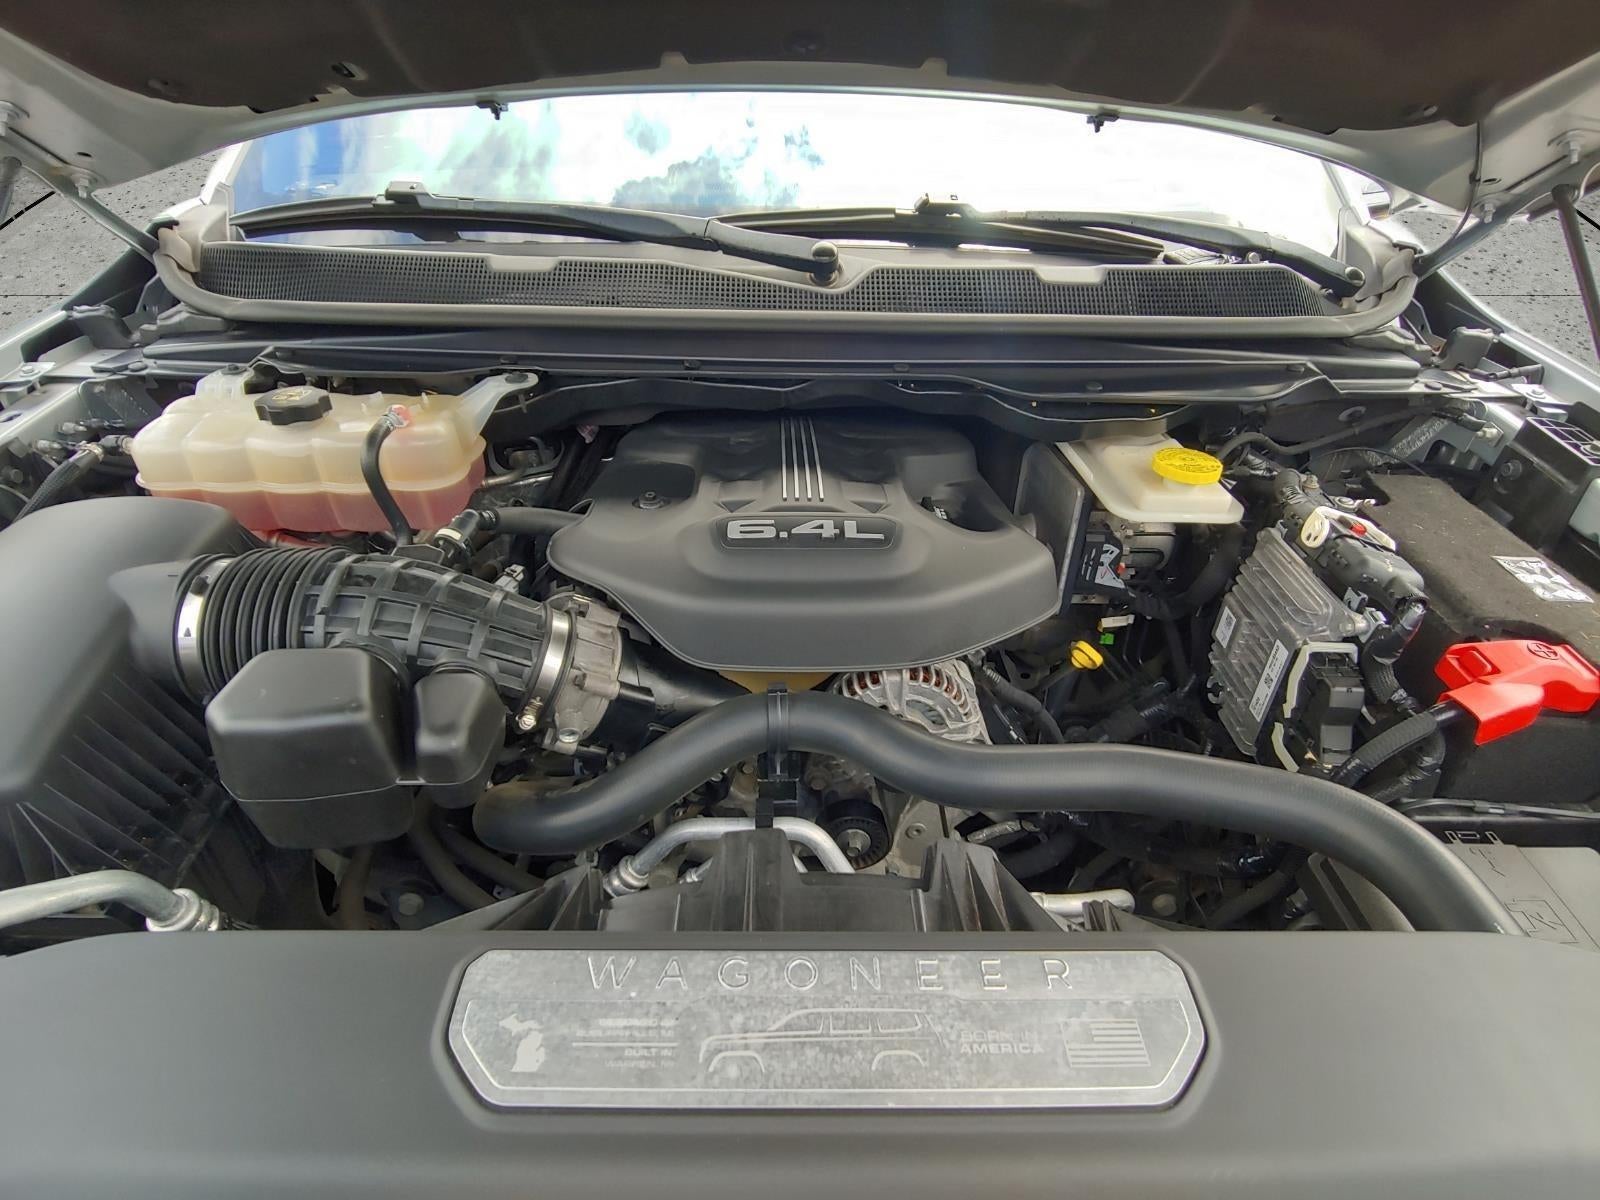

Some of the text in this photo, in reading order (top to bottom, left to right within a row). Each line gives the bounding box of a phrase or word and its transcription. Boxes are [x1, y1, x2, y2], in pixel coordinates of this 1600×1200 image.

[727, 519, 885, 541] 6.4L
[587, 956, 1073, 990] WAGONEER
[960, 1043, 1045, 1055] AMERICA
